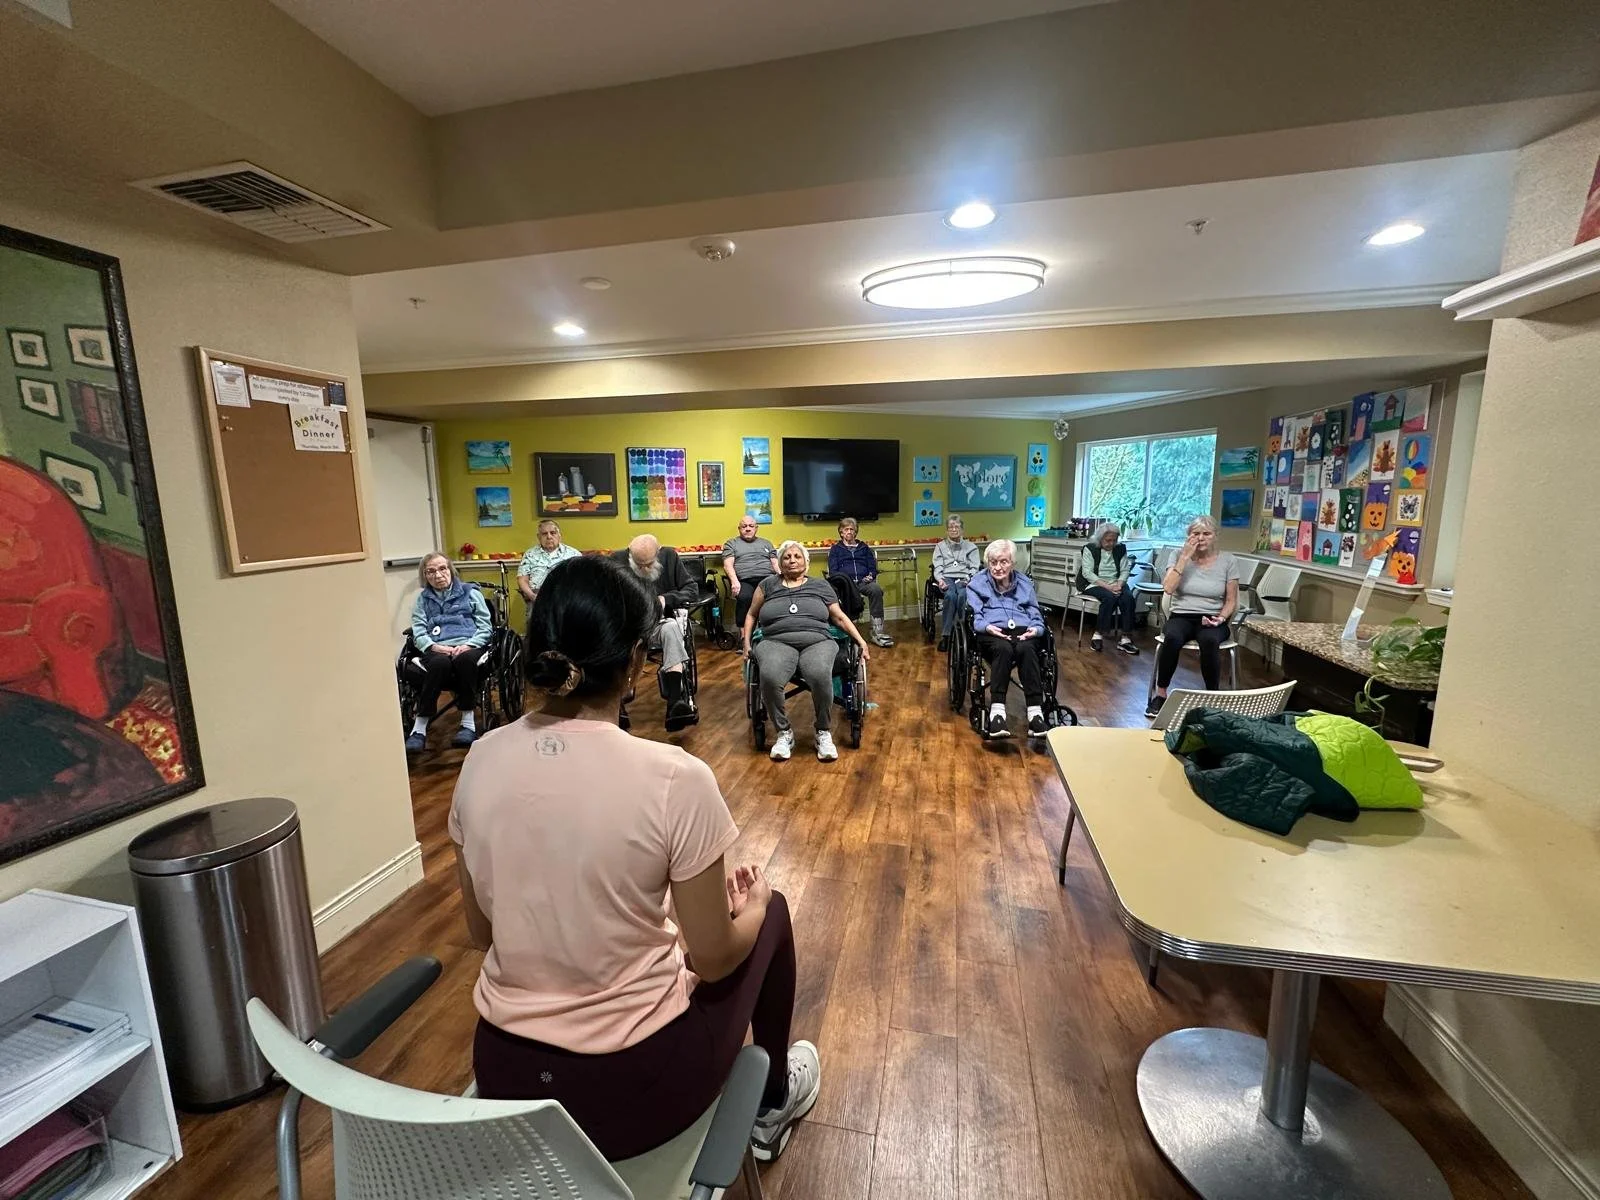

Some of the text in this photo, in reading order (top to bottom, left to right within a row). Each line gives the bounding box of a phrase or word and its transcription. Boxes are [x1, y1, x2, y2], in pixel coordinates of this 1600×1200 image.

[294, 413, 339, 430] Breakfast
[302, 430, 335, 439] Dinner
[958, 469, 1008, 488] explore
